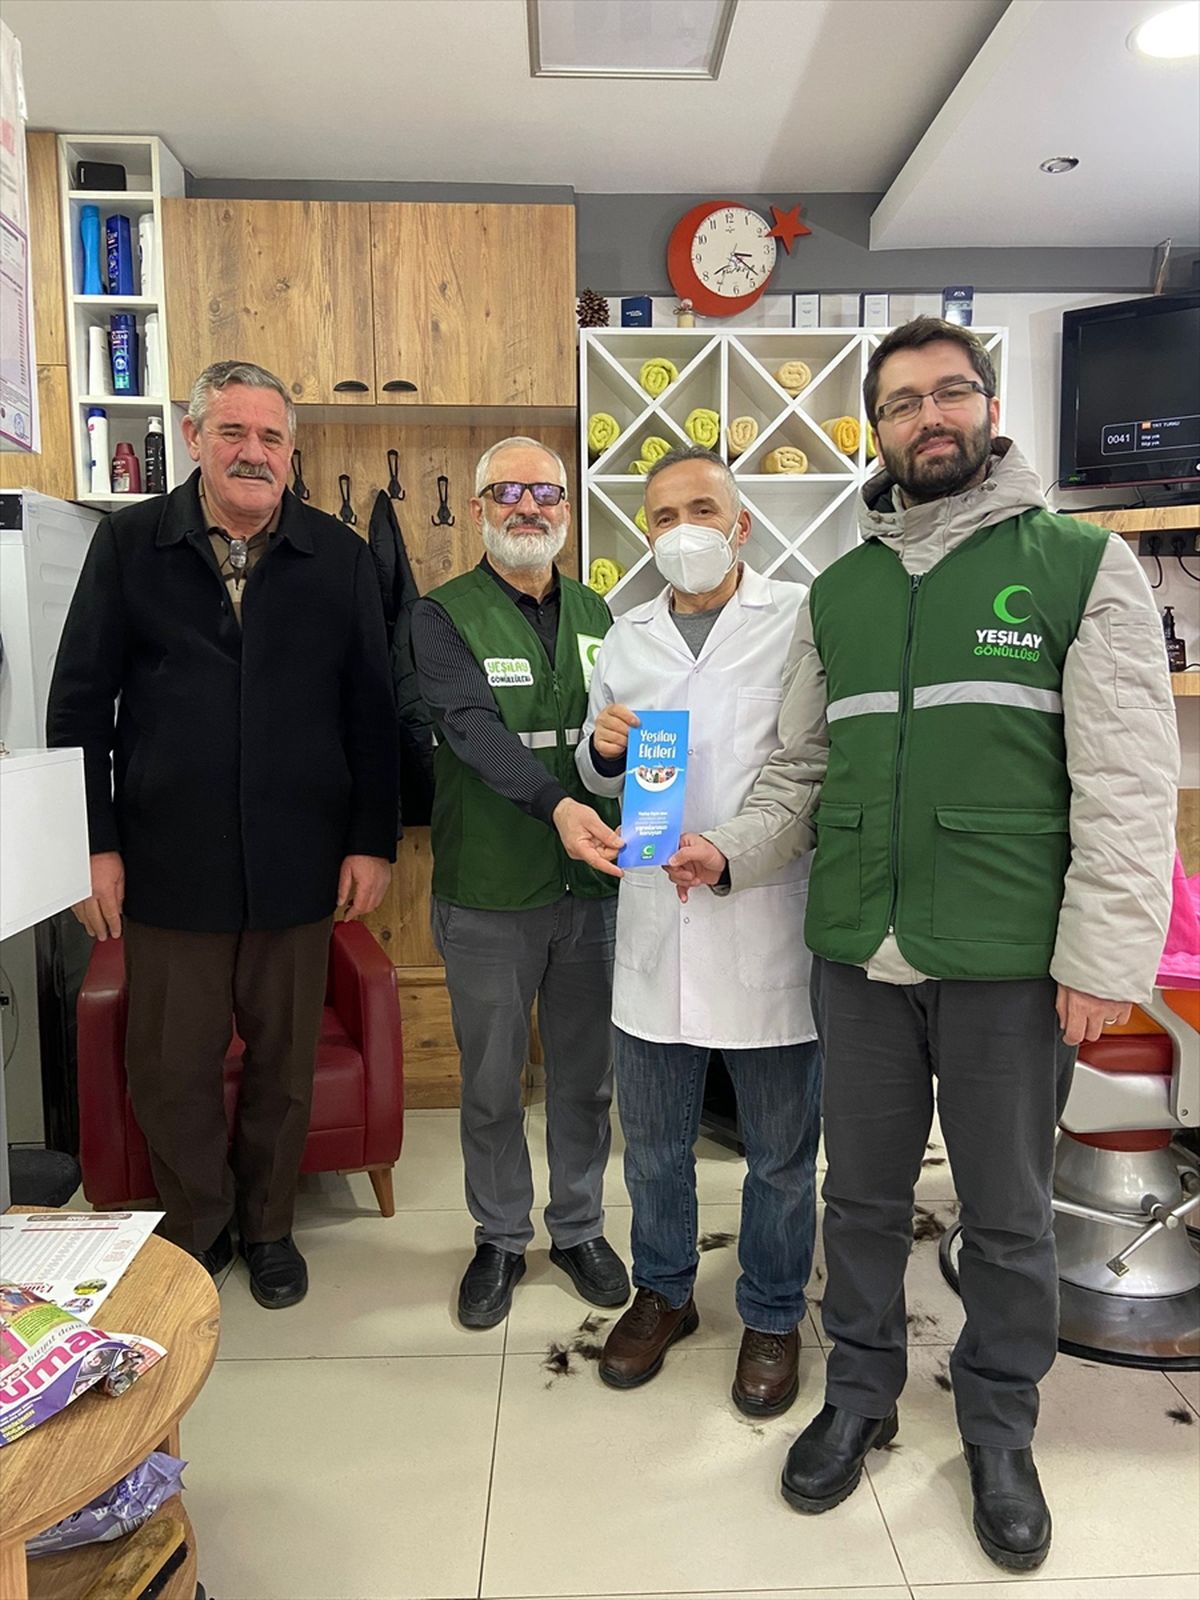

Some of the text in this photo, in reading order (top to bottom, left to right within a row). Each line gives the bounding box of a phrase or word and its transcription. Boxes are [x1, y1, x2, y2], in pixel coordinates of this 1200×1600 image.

[724, 212, 735, 224] 12
[709, 219, 717, 231] 11
[698, 234, 708, 246] 10
[763, 244, 770, 255] 3
[695, 253, 702, 264] 9
[702, 271, 710, 282] 8
[733, 284, 740, 295] 6
[1107, 433, 1130, 445] 0041
[974, 645, 1040, 662] GÖNÜLLÜSÜ
[640, 729, 677, 745] Yeşilay
[638, 743, 676, 760] Elçileri
